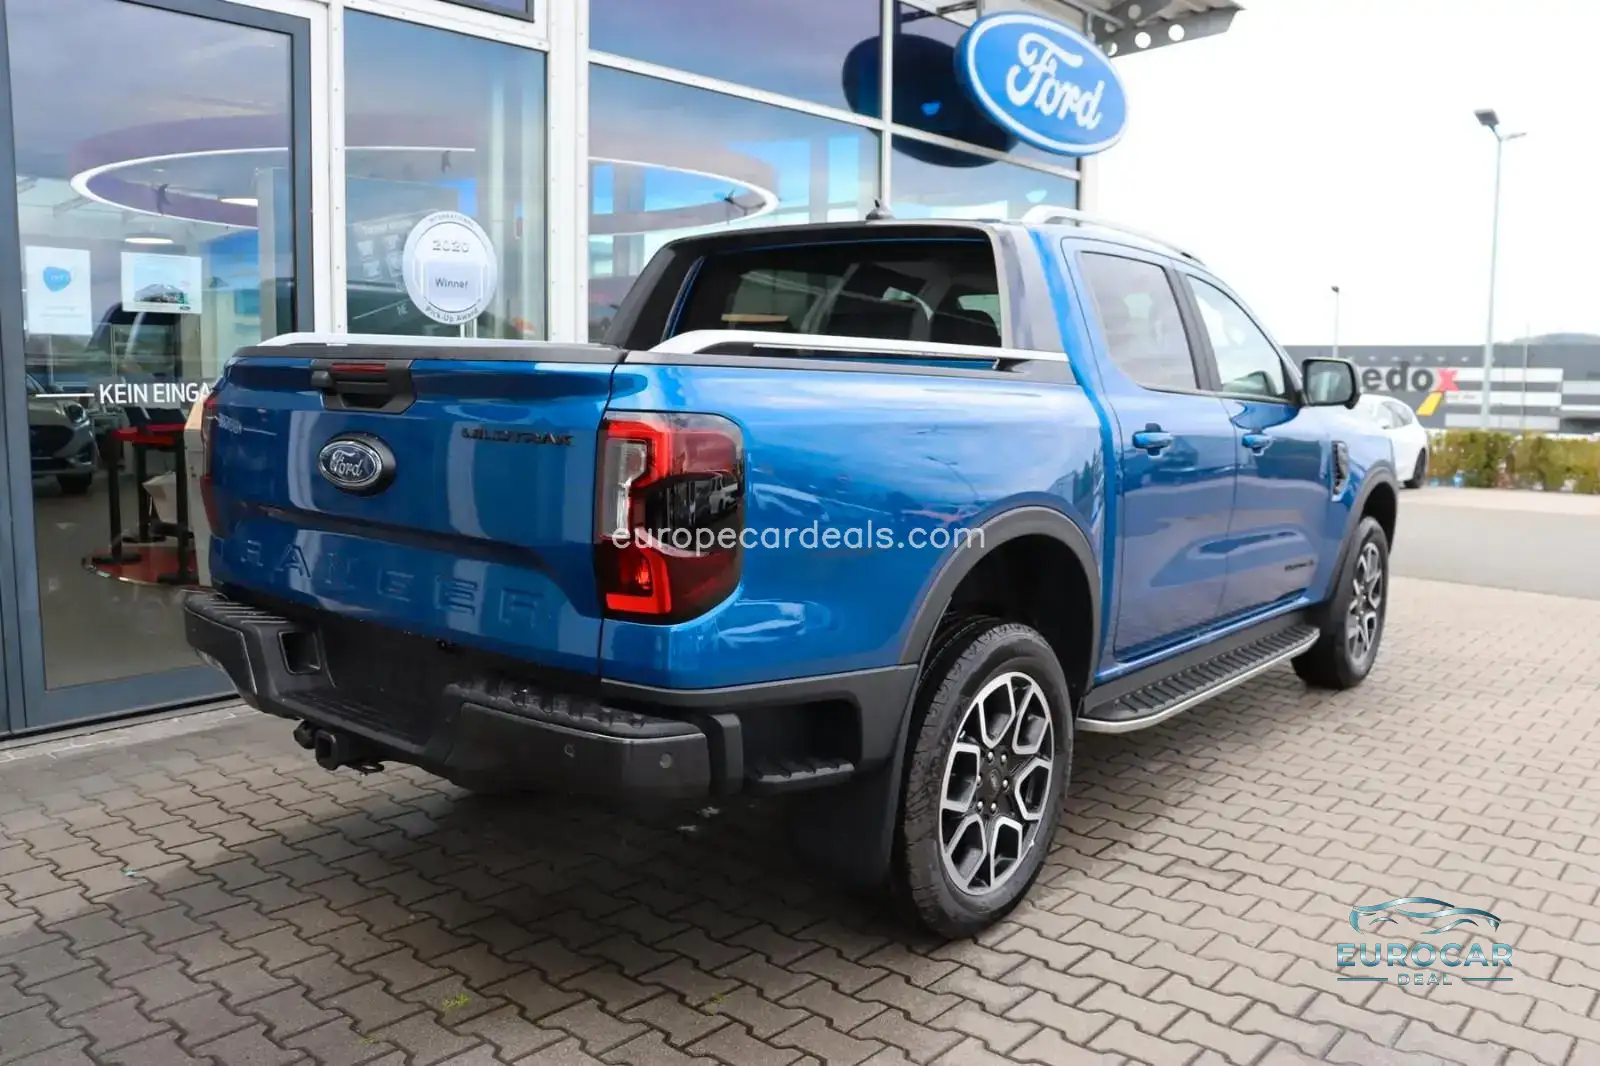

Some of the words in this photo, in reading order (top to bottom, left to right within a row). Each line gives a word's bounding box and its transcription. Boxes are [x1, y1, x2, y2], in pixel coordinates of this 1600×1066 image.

[1006, 32, 1105, 130] Ford
[432, 240, 470, 253] 2020
[435, 277, 469, 289] Winner
[1361, 361, 1460, 394] edox
[100, 383, 148, 404] KEIN
[329, 449, 364, 476] Ford
